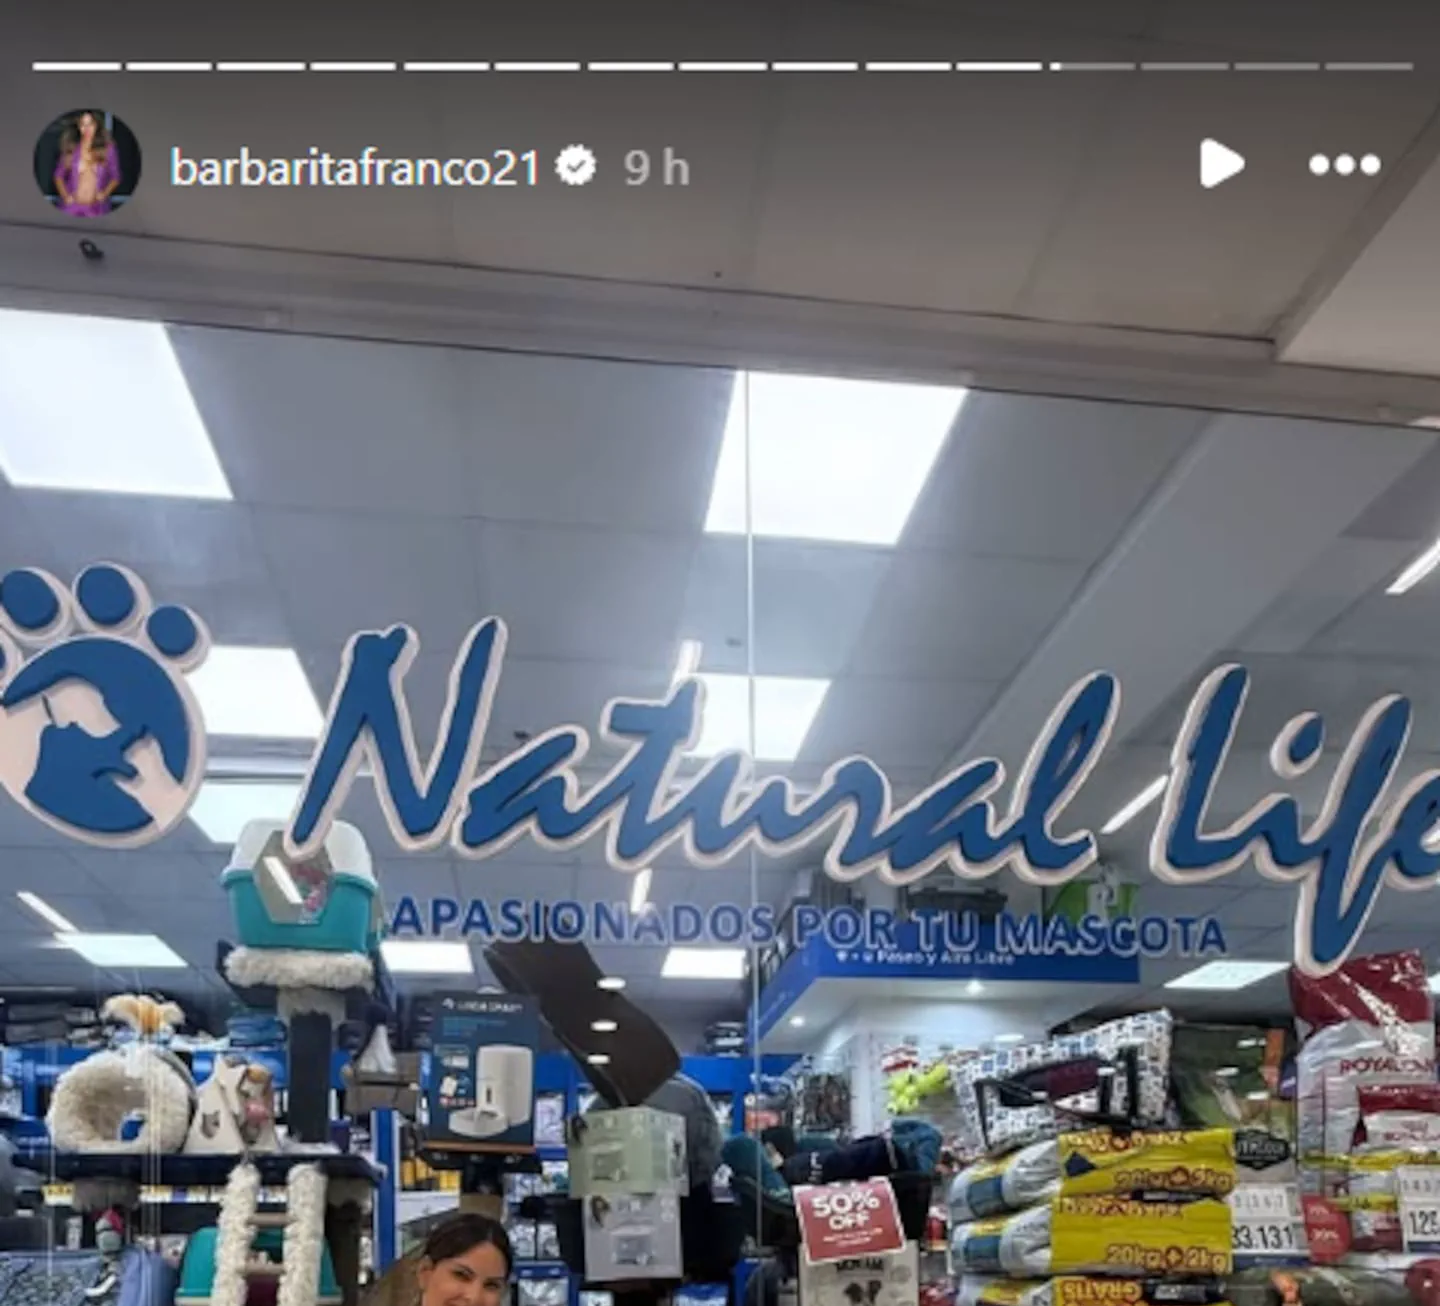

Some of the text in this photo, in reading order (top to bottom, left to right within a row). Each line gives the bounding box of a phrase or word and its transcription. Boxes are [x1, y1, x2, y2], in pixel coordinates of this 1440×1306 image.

[284, 616, 1440, 978] Natural Life
[387, 894, 1228, 958] APASIONADOS POR TU MASCOTA
[812, 1190, 879, 1218] 50%
[829, 1211, 869, 1230] OFF
[1062, 1279, 1142, 1301] GRATIS
